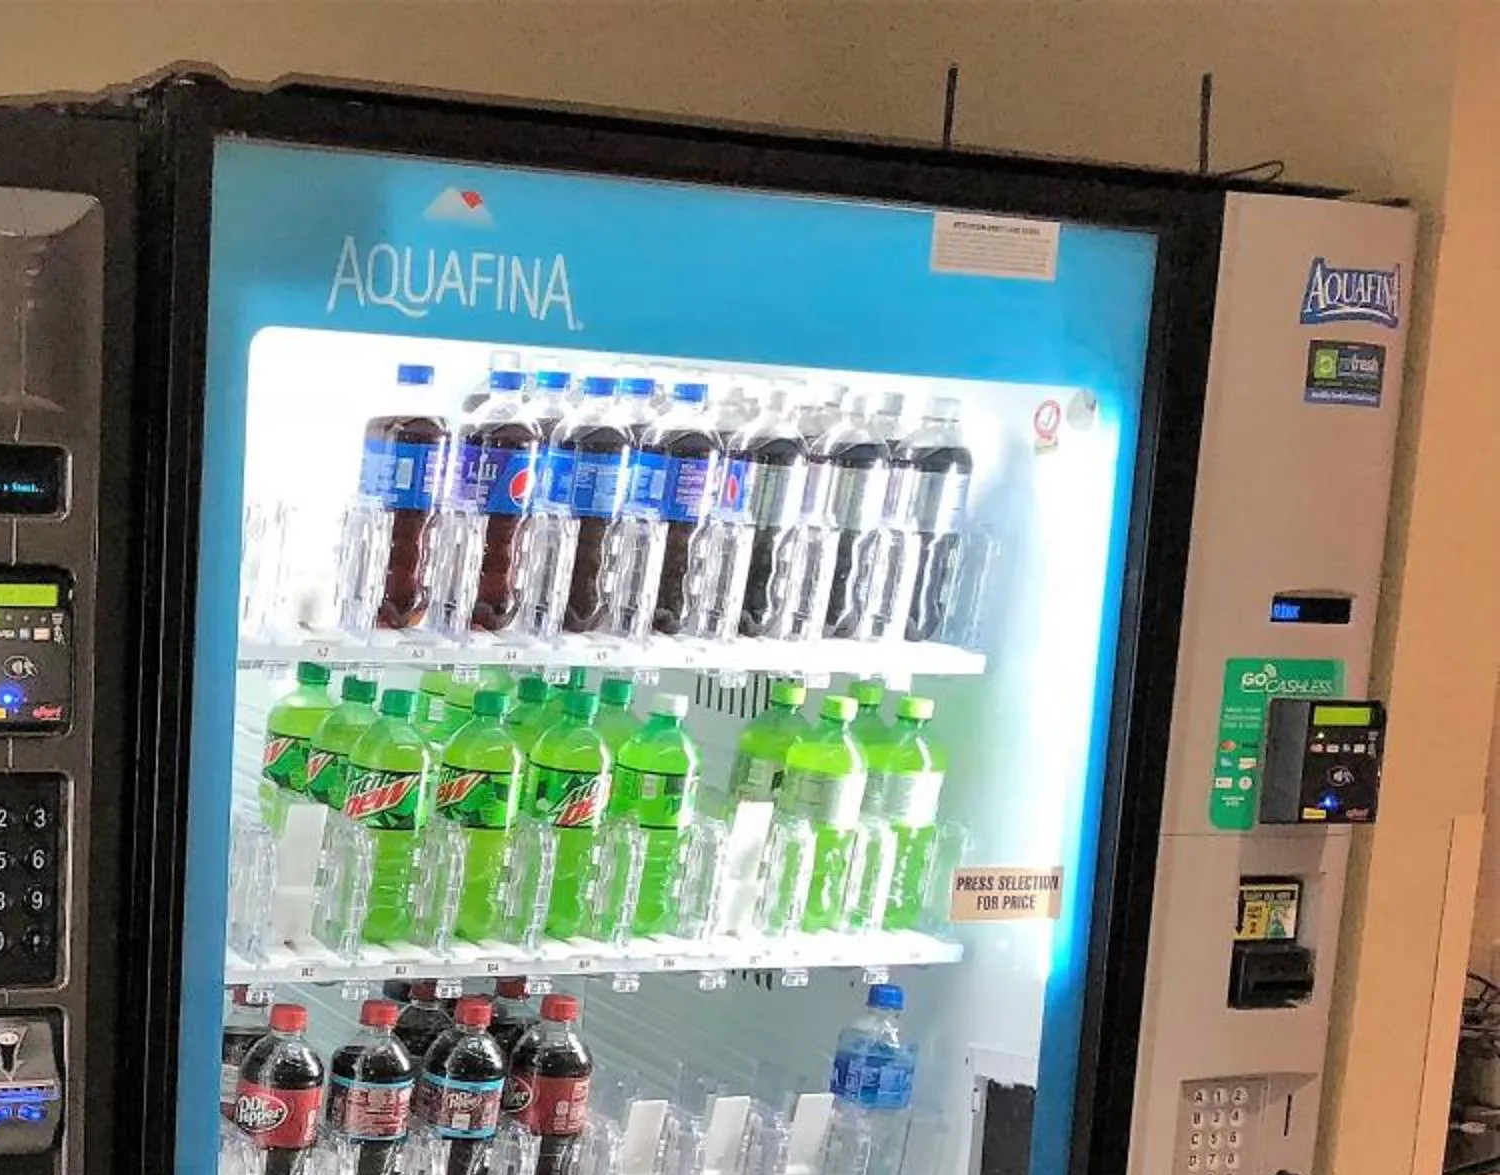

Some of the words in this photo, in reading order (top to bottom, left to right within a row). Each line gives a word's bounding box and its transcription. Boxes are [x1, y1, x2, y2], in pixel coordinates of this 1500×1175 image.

[327, 235, 579, 332] AQUAFINA
[1241, 671, 1268, 687] GO
[33, 807, 46, 829] 3
[31, 849, 45, 869] 6
[956, 875, 995, 891] PRESS
[998, 875, 1060, 891] SELECTION
[31, 890, 43, 910] 9
[976, 895, 999, 911] FOR
[1002, 894, 1037, 910] PRICE
